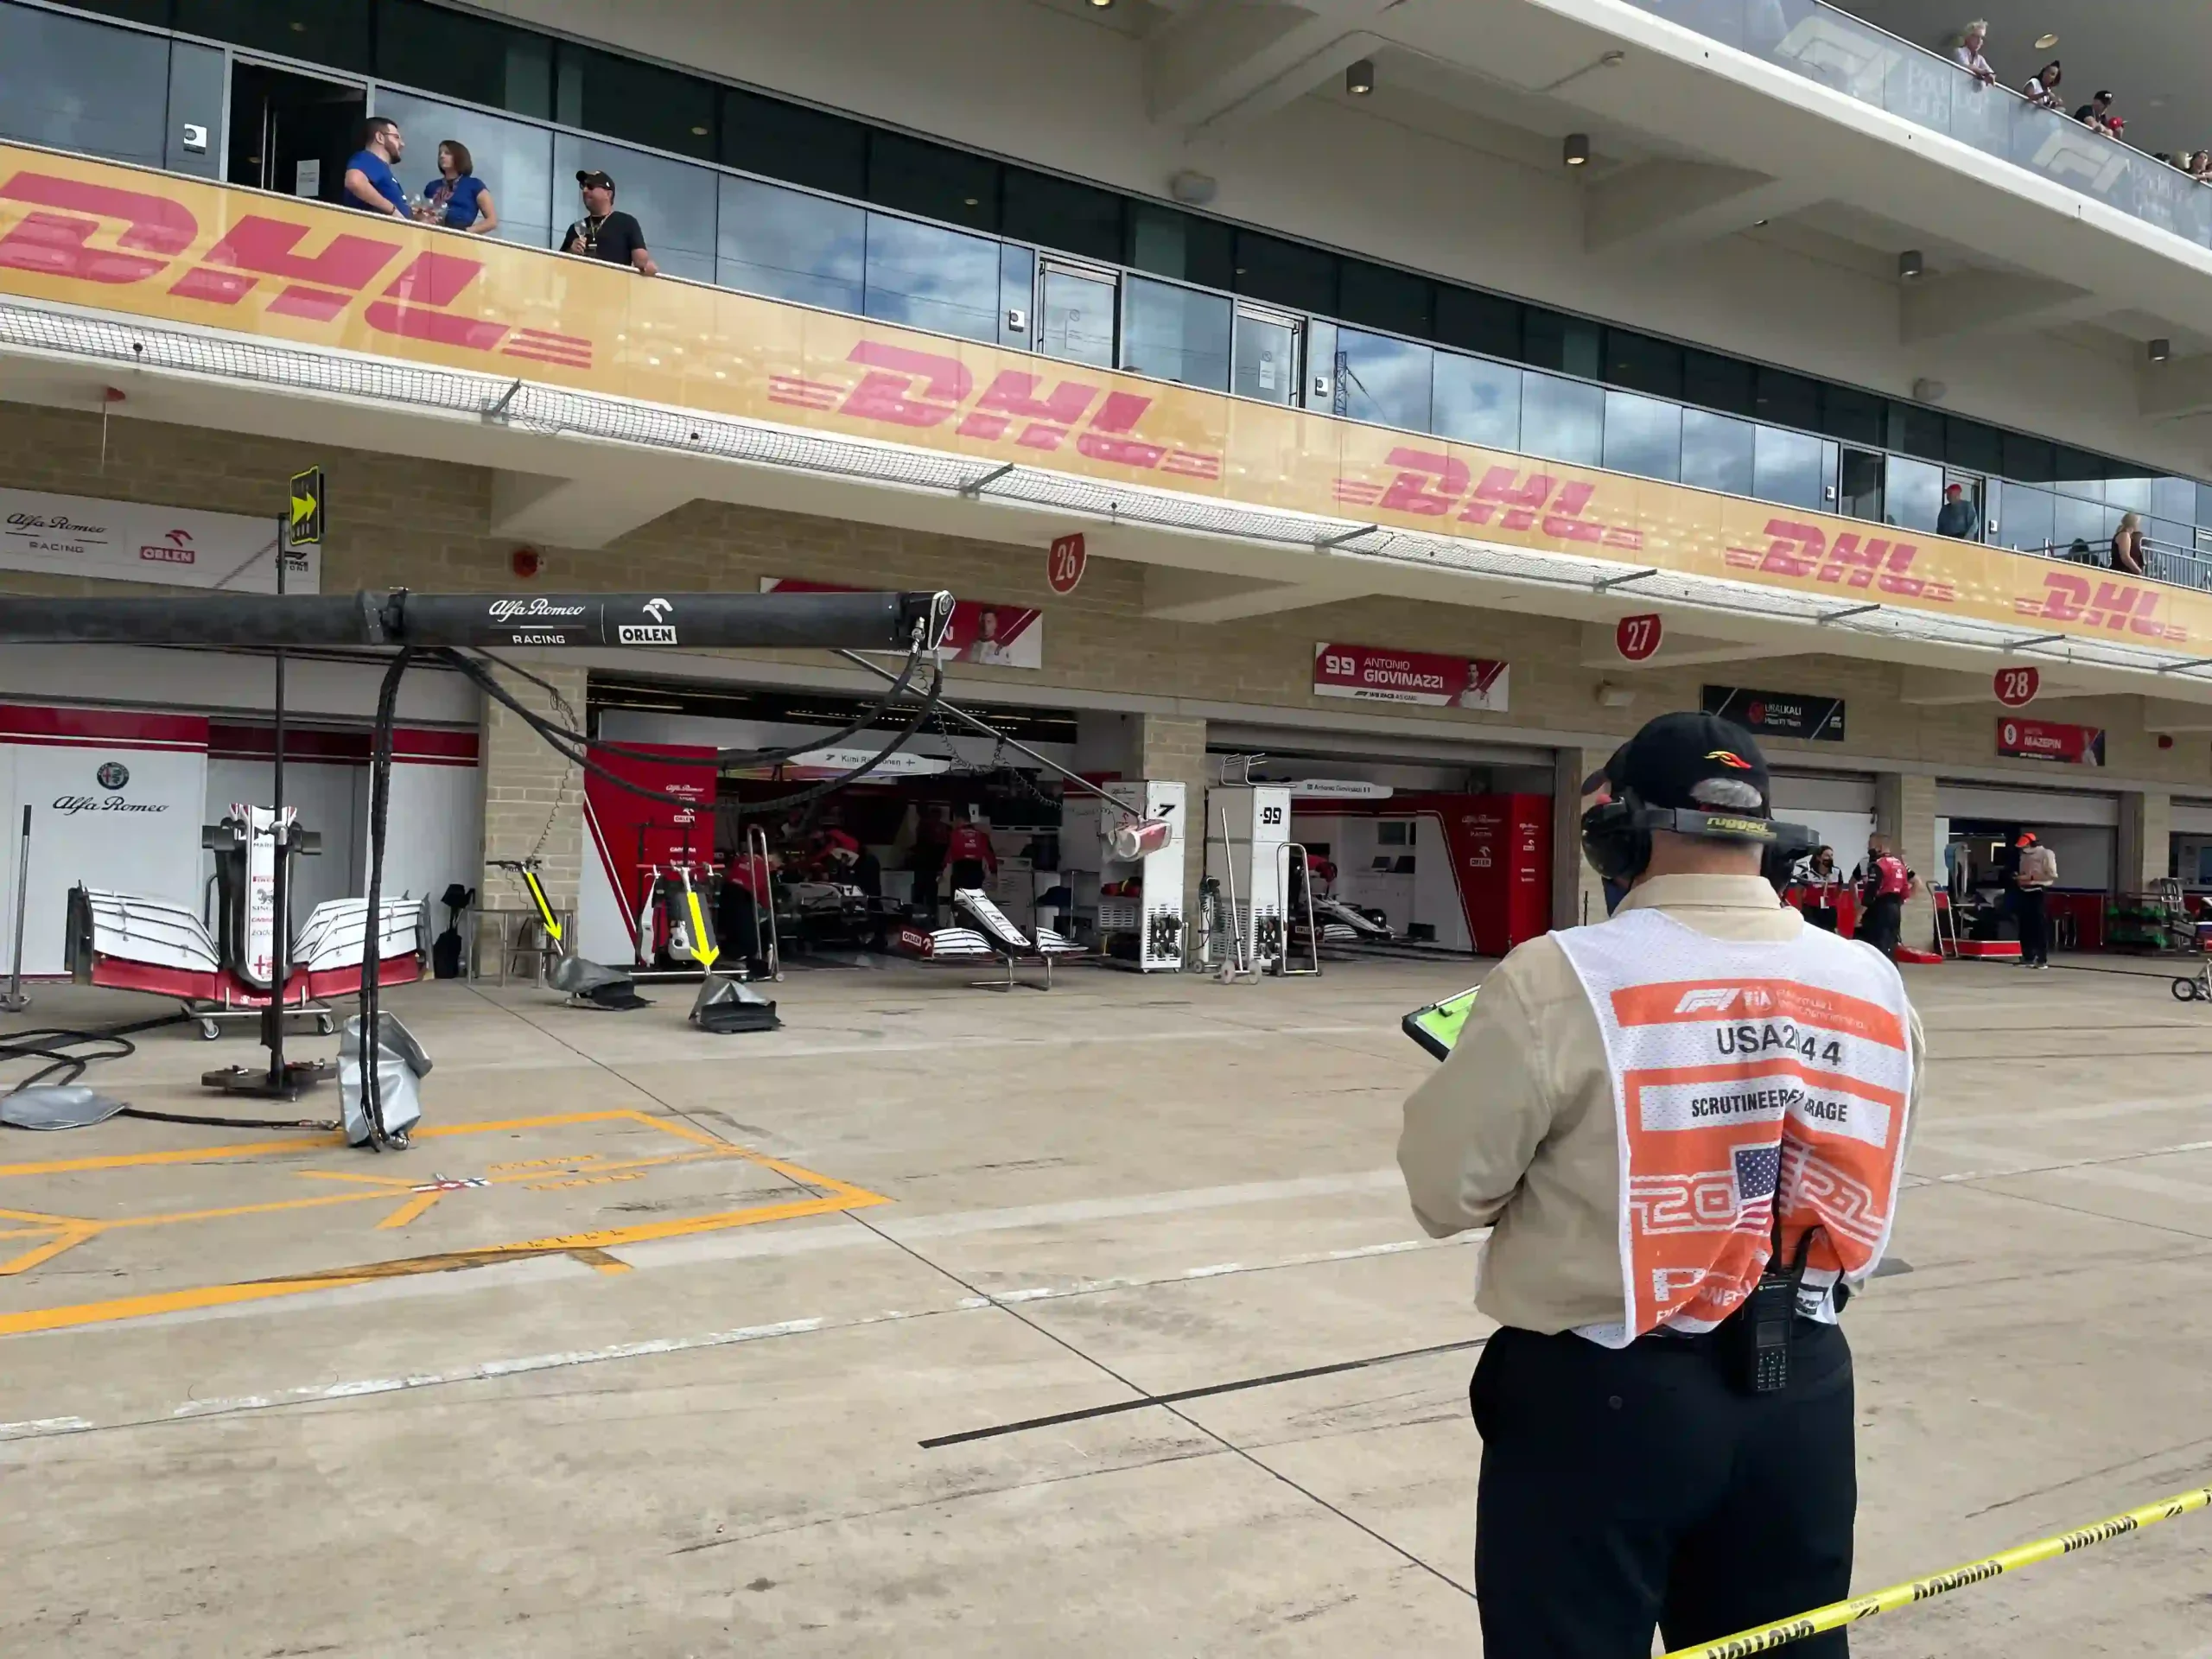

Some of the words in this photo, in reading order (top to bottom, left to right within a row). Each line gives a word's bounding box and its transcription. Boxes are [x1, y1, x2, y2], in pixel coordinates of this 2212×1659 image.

[0, 171, 512, 352] DHL
[837, 340, 1169, 469] DHL
[1379, 447, 1607, 543] DHL
[7, 512, 45, 532] Alfa
[50, 514, 108, 534] Romeo
[29, 541, 85, 555] RACING
[142, 547, 194, 563] ORLEN
[1759, 518, 1926, 597] DHL
[1055, 541, 1076, 582] 26
[489, 599, 528, 622] Alfa
[528, 598, 586, 616] Romeo
[2040, 571, 2164, 638] DHL
[512, 634, 566, 645] RACING
[622, 628, 673, 642] ORLEN
[1627, 620, 1651, 652] 27
[1325, 655, 1356, 676] 99
[1363, 657, 1410, 671] ANTONIO
[1363, 669, 1444, 689] GIOVINAZZI
[2004, 671, 2029, 699] 28
[53, 795, 101, 816] Alfa
[101, 795, 169, 812] Romeo
[1158, 803, 1177, 817] 7
[1263, 806, 1282, 824] 99
[1707, 817, 1768, 832] rugged
[903, 932, 922, 946] ORLEN
